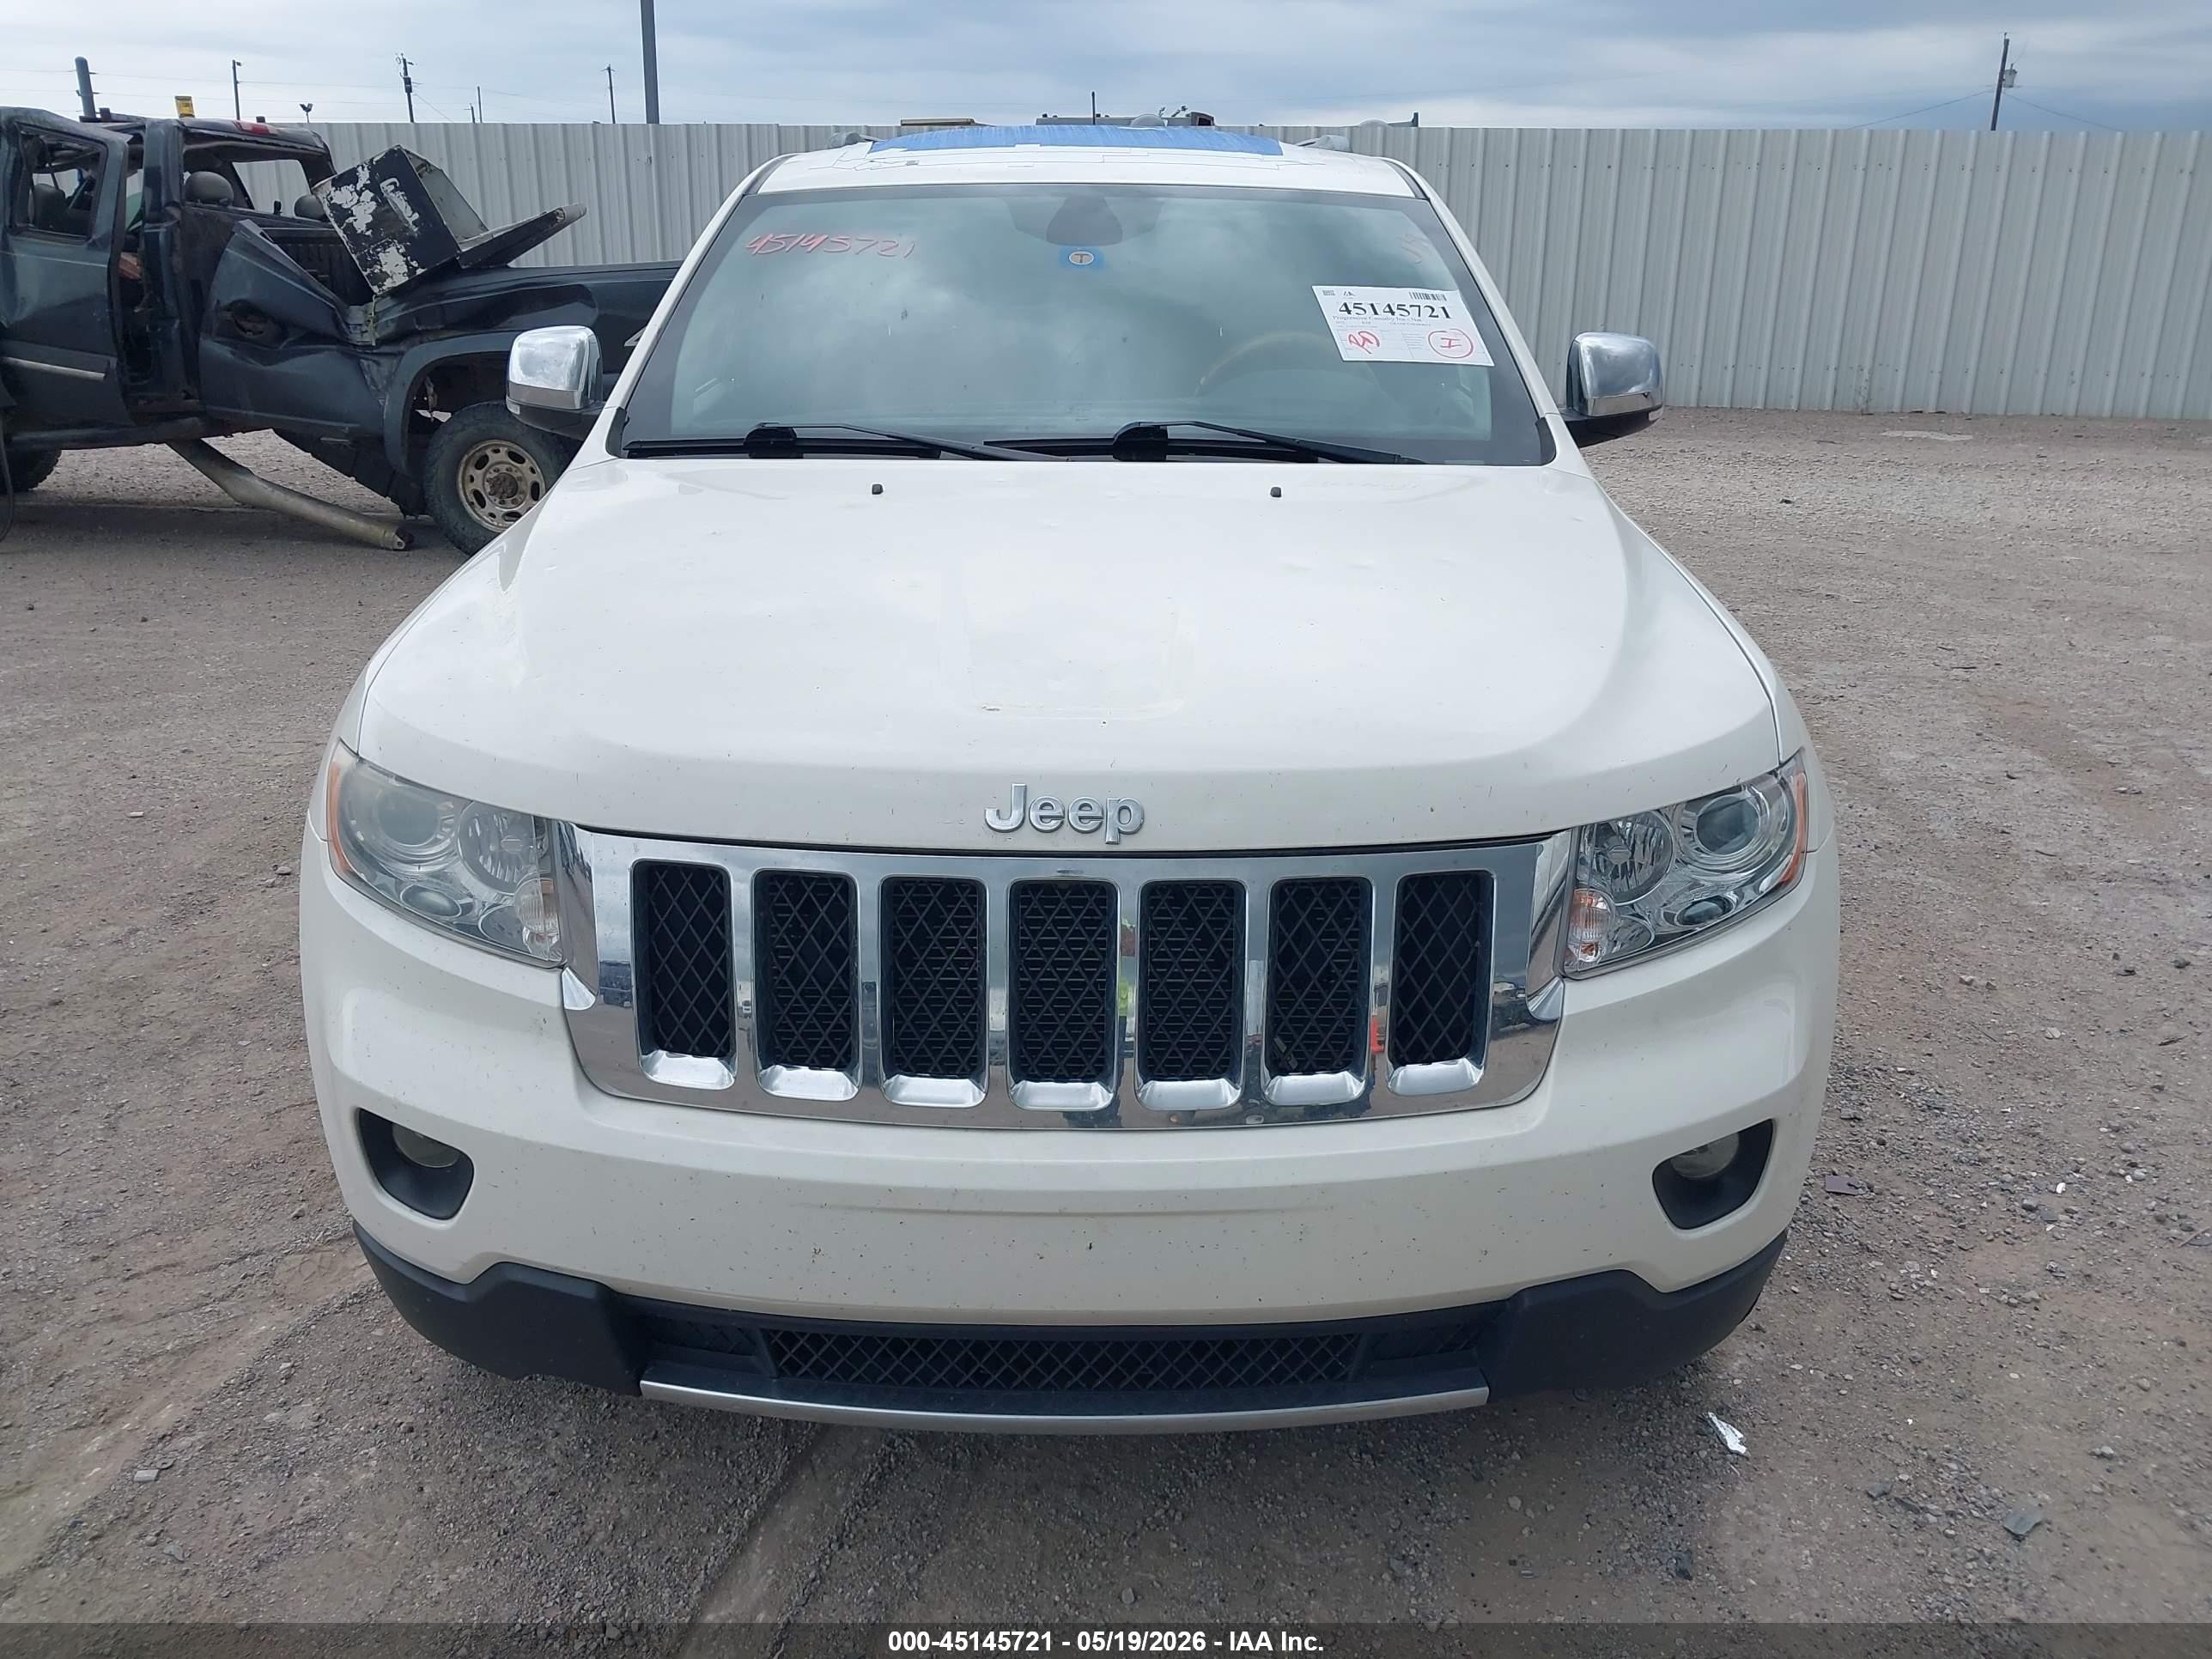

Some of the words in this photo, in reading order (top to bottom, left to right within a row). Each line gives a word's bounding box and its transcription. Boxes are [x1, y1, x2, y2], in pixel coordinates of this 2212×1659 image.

[745, 234, 915, 258] 45145721
[1339, 301, 1452, 319] 45145721
[985, 783, 1144, 845] Jeep
